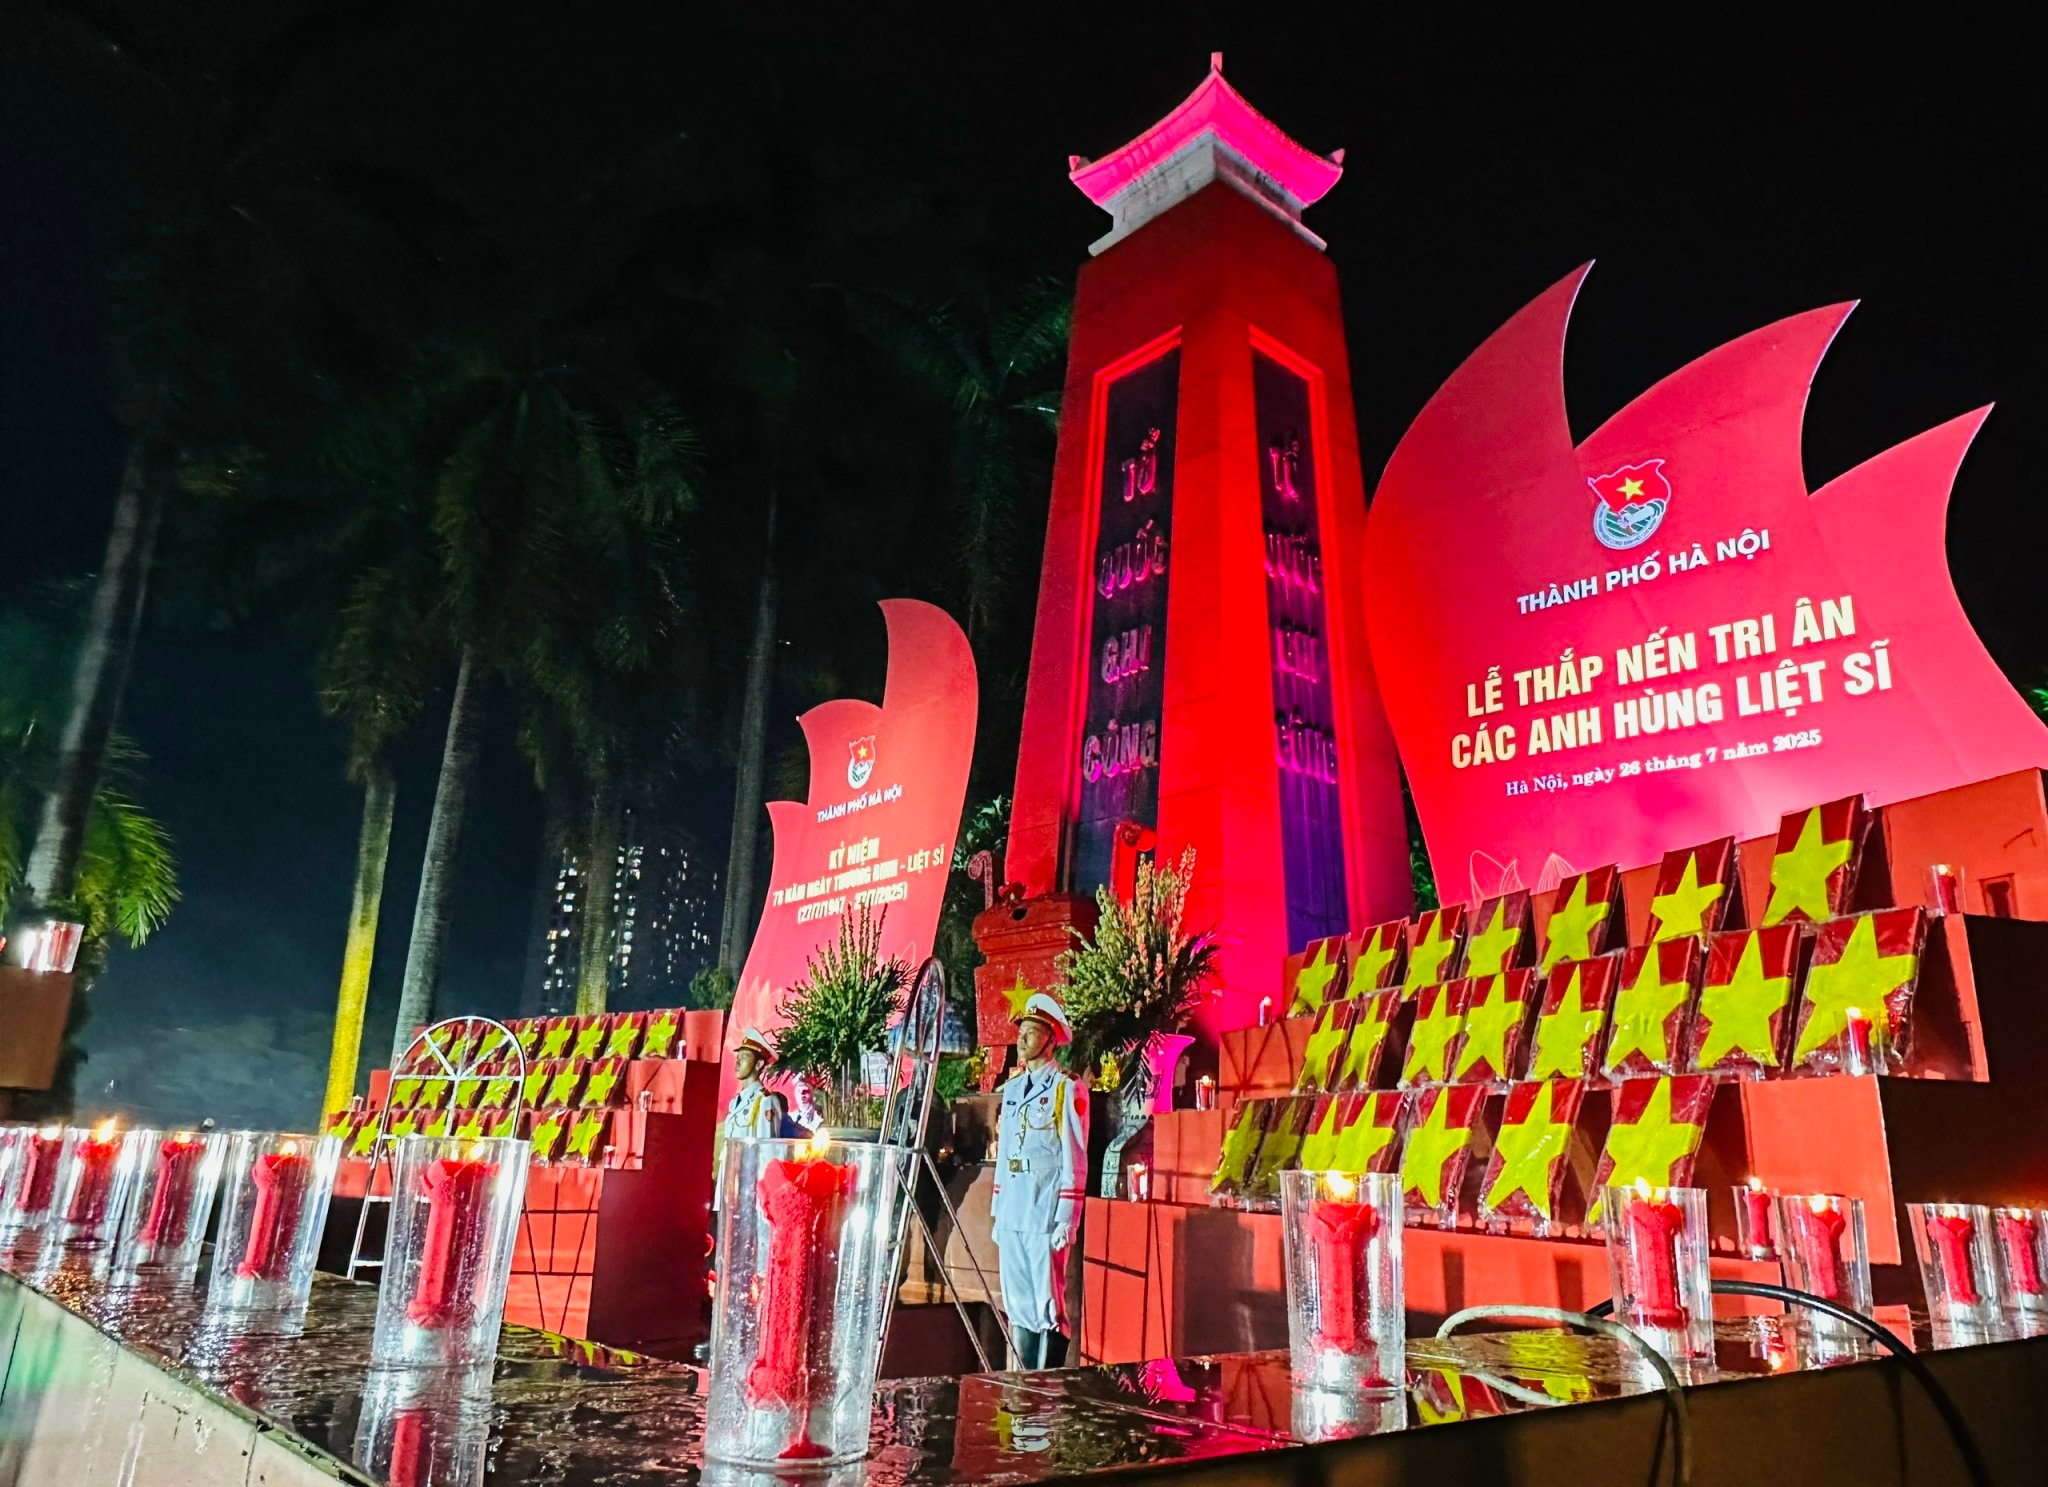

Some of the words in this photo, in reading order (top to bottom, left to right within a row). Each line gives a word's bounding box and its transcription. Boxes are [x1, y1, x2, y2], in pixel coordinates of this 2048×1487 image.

[1517, 576, 1598, 615] THÀNH
[1605, 551, 1661, 592] PHỐ
[1669, 543, 1709, 575] HÀ
[1716, 528, 1770, 561] NỘI
[1101, 625, 1152, 684] GHI
[1467, 665, 1504, 718] LỄ
[1513, 647, 1604, 707] THẮP
[1616, 626, 1698, 686] NẾN
[1708, 614, 1777, 664] TRI
[1792, 595, 1856, 647] ÂN
[1451, 722, 1517, 769] CÁC
[1527, 706, 1602, 756] ANH
[1613, 683, 1724, 740] HÙNG
[1736, 658, 1827, 717] LIỆT
[1843, 638, 1892, 696] SĨ
[1083, 718, 1159, 783] CÔNG
[1505, 781, 1529, 796] Hà
[1534, 773, 1568, 792] Nội,
[1572, 767, 1615, 788] ngày
[1618, 760, 1642, 777] 26
[1645, 751, 1702, 774] tháng
[1705, 747, 1718, 763] 7
[1723, 740, 1768, 761] năm
[1772, 729, 1823, 752] 2025
[816, 802, 847, 823] THÀNH
[847, 792, 868, 814] PHỐ
[868, 788, 883, 807] HÀ
[883, 783, 903, 803] NỘI
[847, 837, 880, 866] NIỆM
[907, 849, 931, 874] LIỆT
